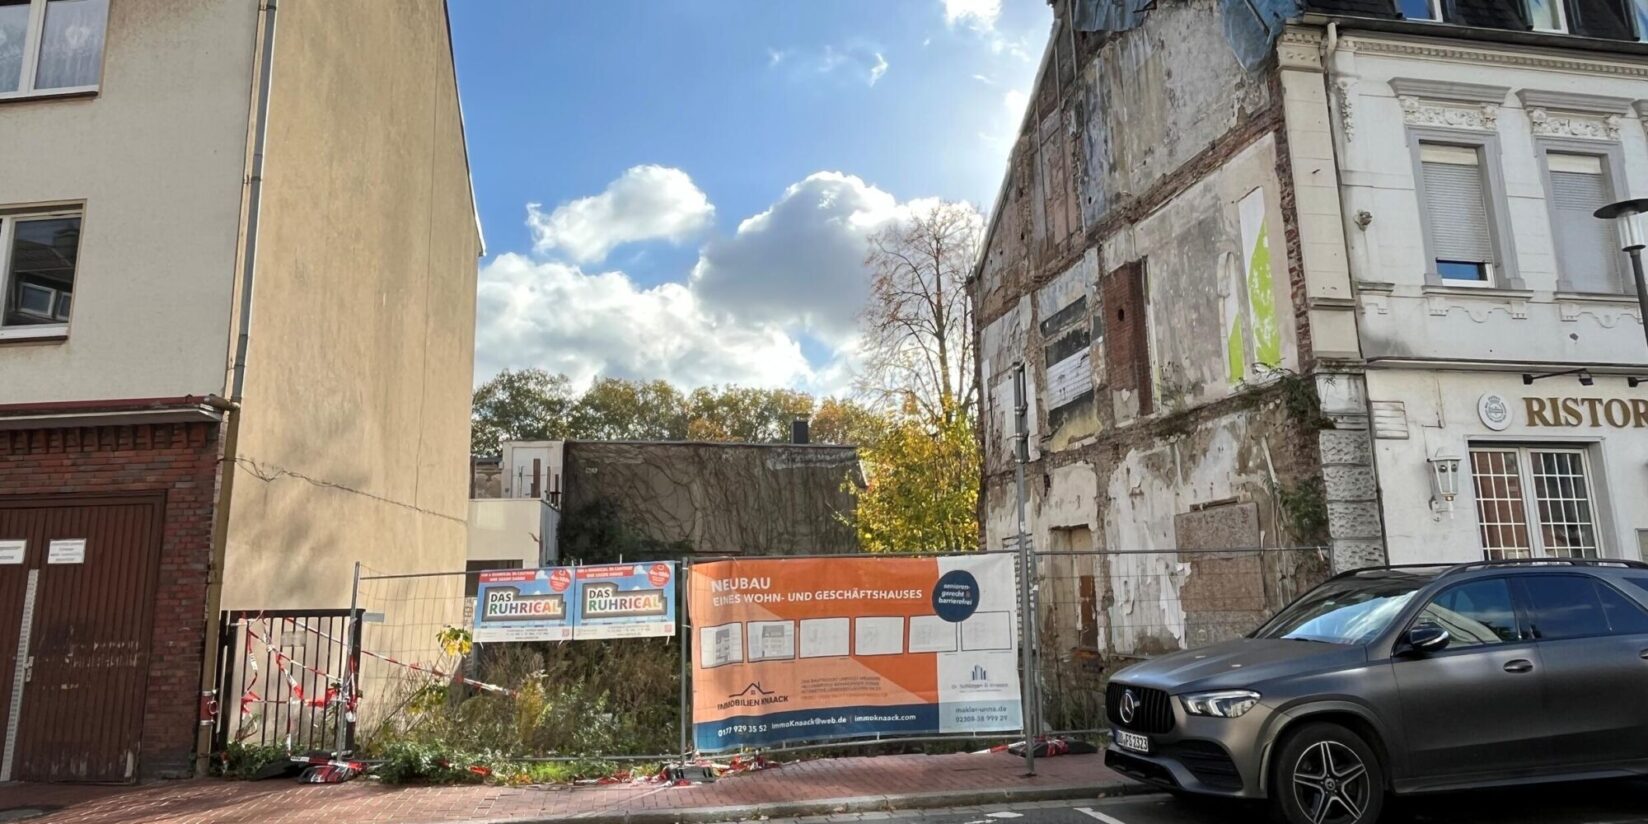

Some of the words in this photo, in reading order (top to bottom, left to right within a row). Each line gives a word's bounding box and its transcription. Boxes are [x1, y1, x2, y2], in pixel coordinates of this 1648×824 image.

[1521, 397, 1648, 428] RISTOR
[711, 577, 771, 593] NEUBAU
[490, 593, 512, 603] DAS
[589, 589, 610, 599] DAS
[713, 594, 741, 607] EINES
[743, 593, 785, 603] WOHN-
[788, 592, 812, 602] UND
[815, 588, 923, 600] GESCHÄFTSHAUSES
[489, 601, 560, 615] RUHRICAL
[588, 597, 660, 612] RUHRICAL
[717, 699, 760, 710] IMMOBILIEN
[733, 725, 747, 733] 929
[748, 725, 757, 733] 35
[758, 724, 767, 732] 52
